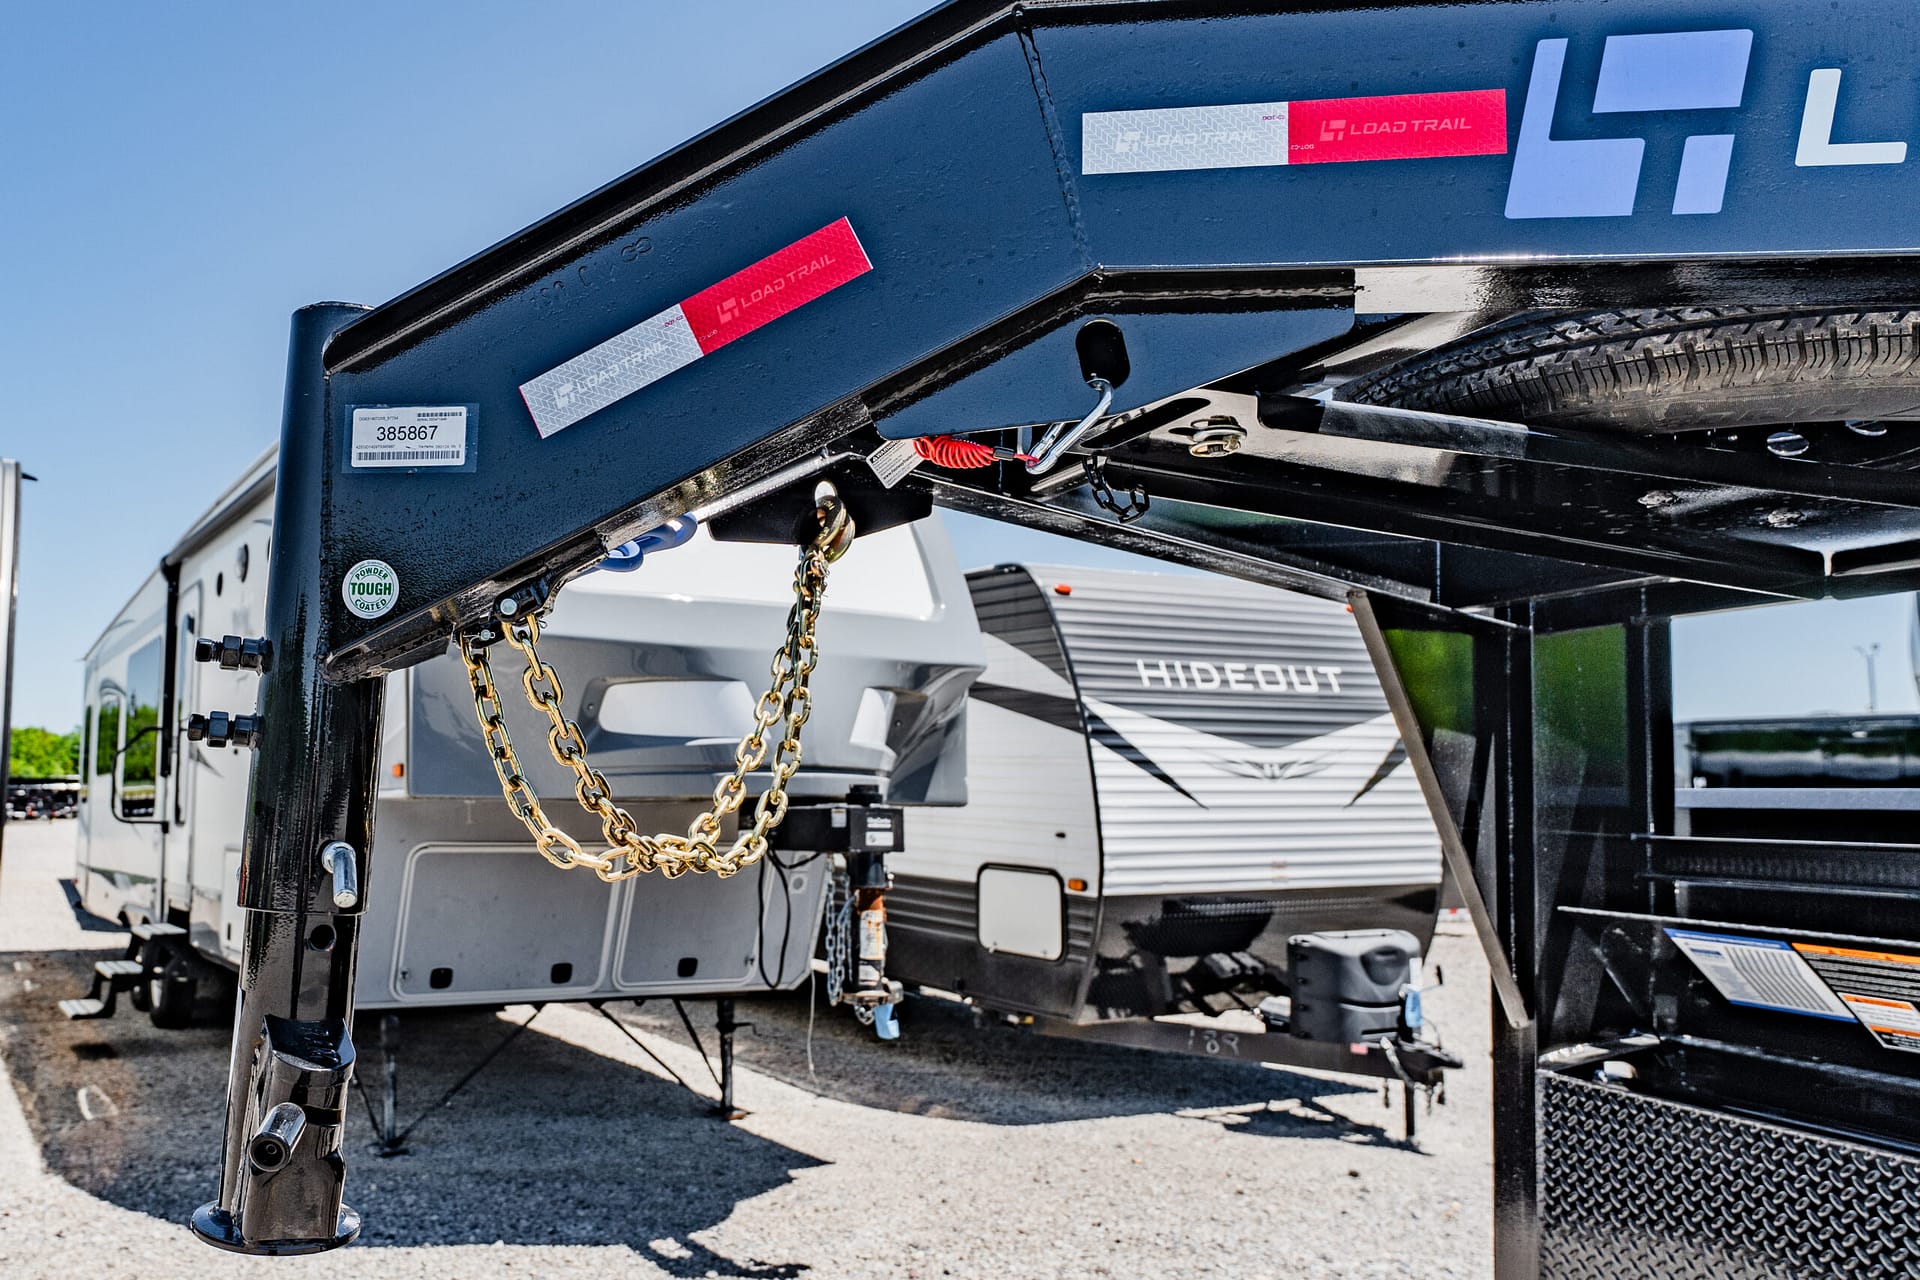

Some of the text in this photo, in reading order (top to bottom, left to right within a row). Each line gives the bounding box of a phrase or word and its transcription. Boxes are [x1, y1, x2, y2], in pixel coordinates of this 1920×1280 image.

[1350, 121, 1406, 135] LOAD
[1411, 118, 1472, 132] TRAIL
[1145, 133, 1197, 146] LOAD
[1202, 129, 1258, 143] TRAIL
[740, 277, 786, 309] LOAD
[786, 254, 836, 283] TRAIL
[577, 364, 620, 393] LOAD
[621, 342, 668, 370] TRAIL
[376, 425, 438, 442] 385867
[354, 567, 389, 580] POWDER
[350, 582, 392, 596] TOUGH
[354, 598, 387, 611] COATED
[1136, 658, 1342, 694] HIDEOUT
